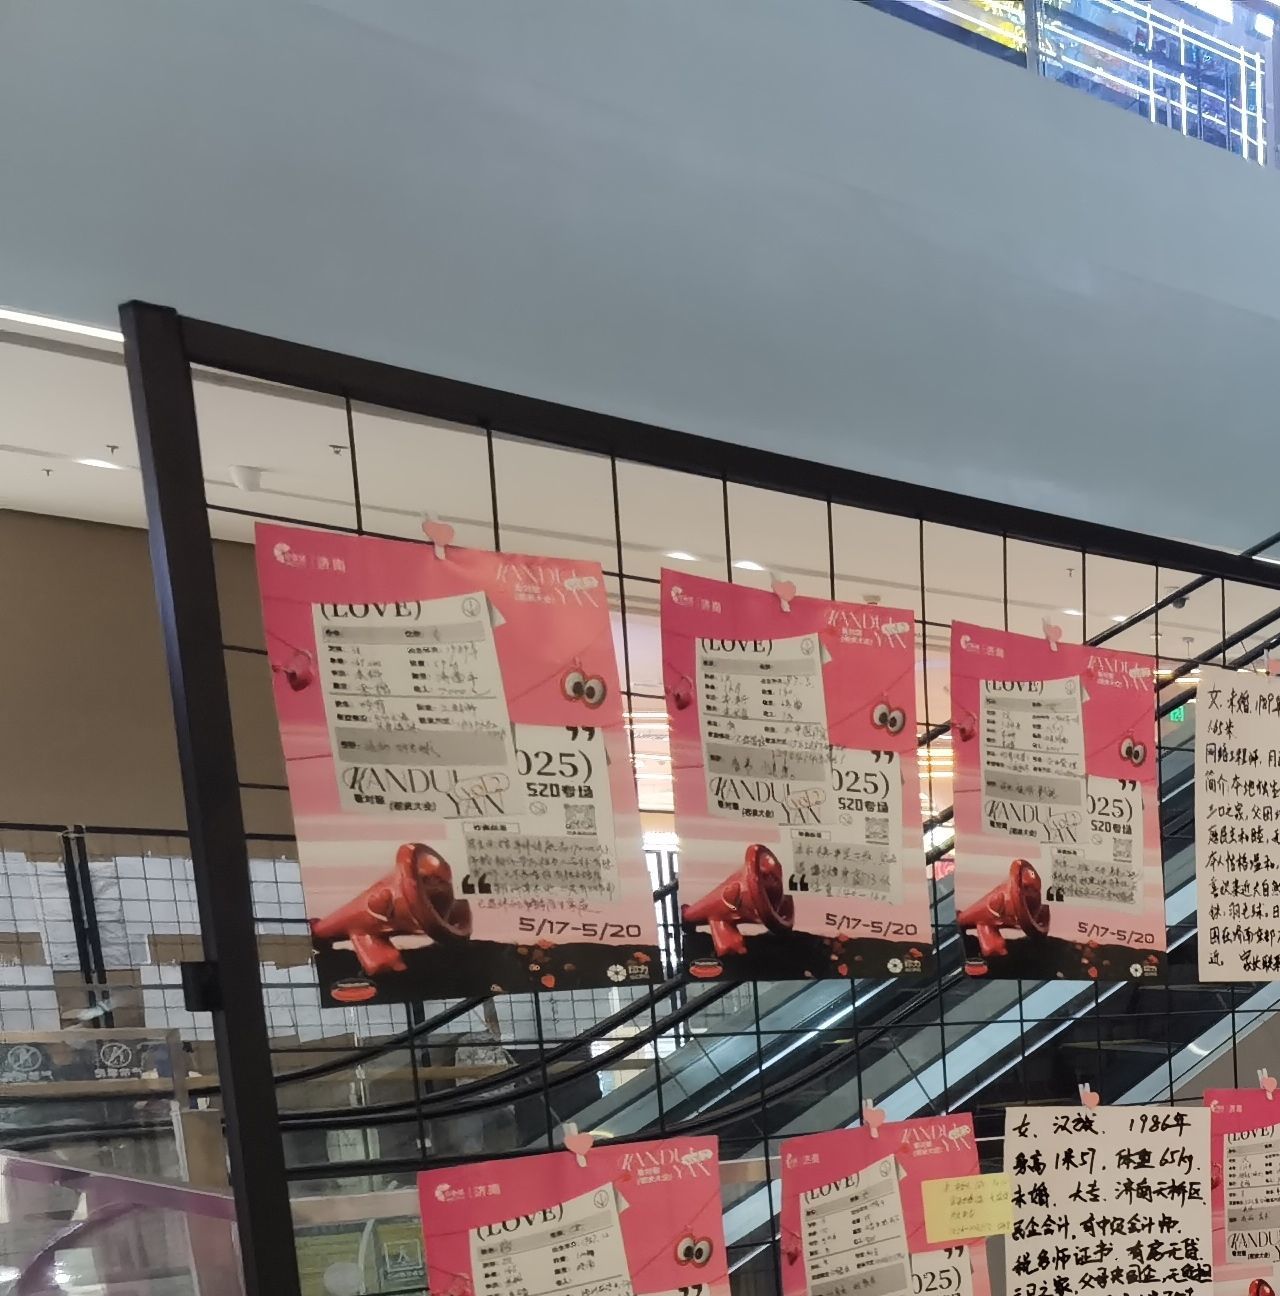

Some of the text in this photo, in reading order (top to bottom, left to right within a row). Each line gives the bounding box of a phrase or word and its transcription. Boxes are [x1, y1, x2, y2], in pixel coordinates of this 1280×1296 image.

[519, 916, 641, 940] 5/17-5/20
[825, 913, 918, 937] 5/17-5/20
[1077, 921, 1155, 944] 5/17-5/20
[1129, 1112, 1192, 1137] 1986年
